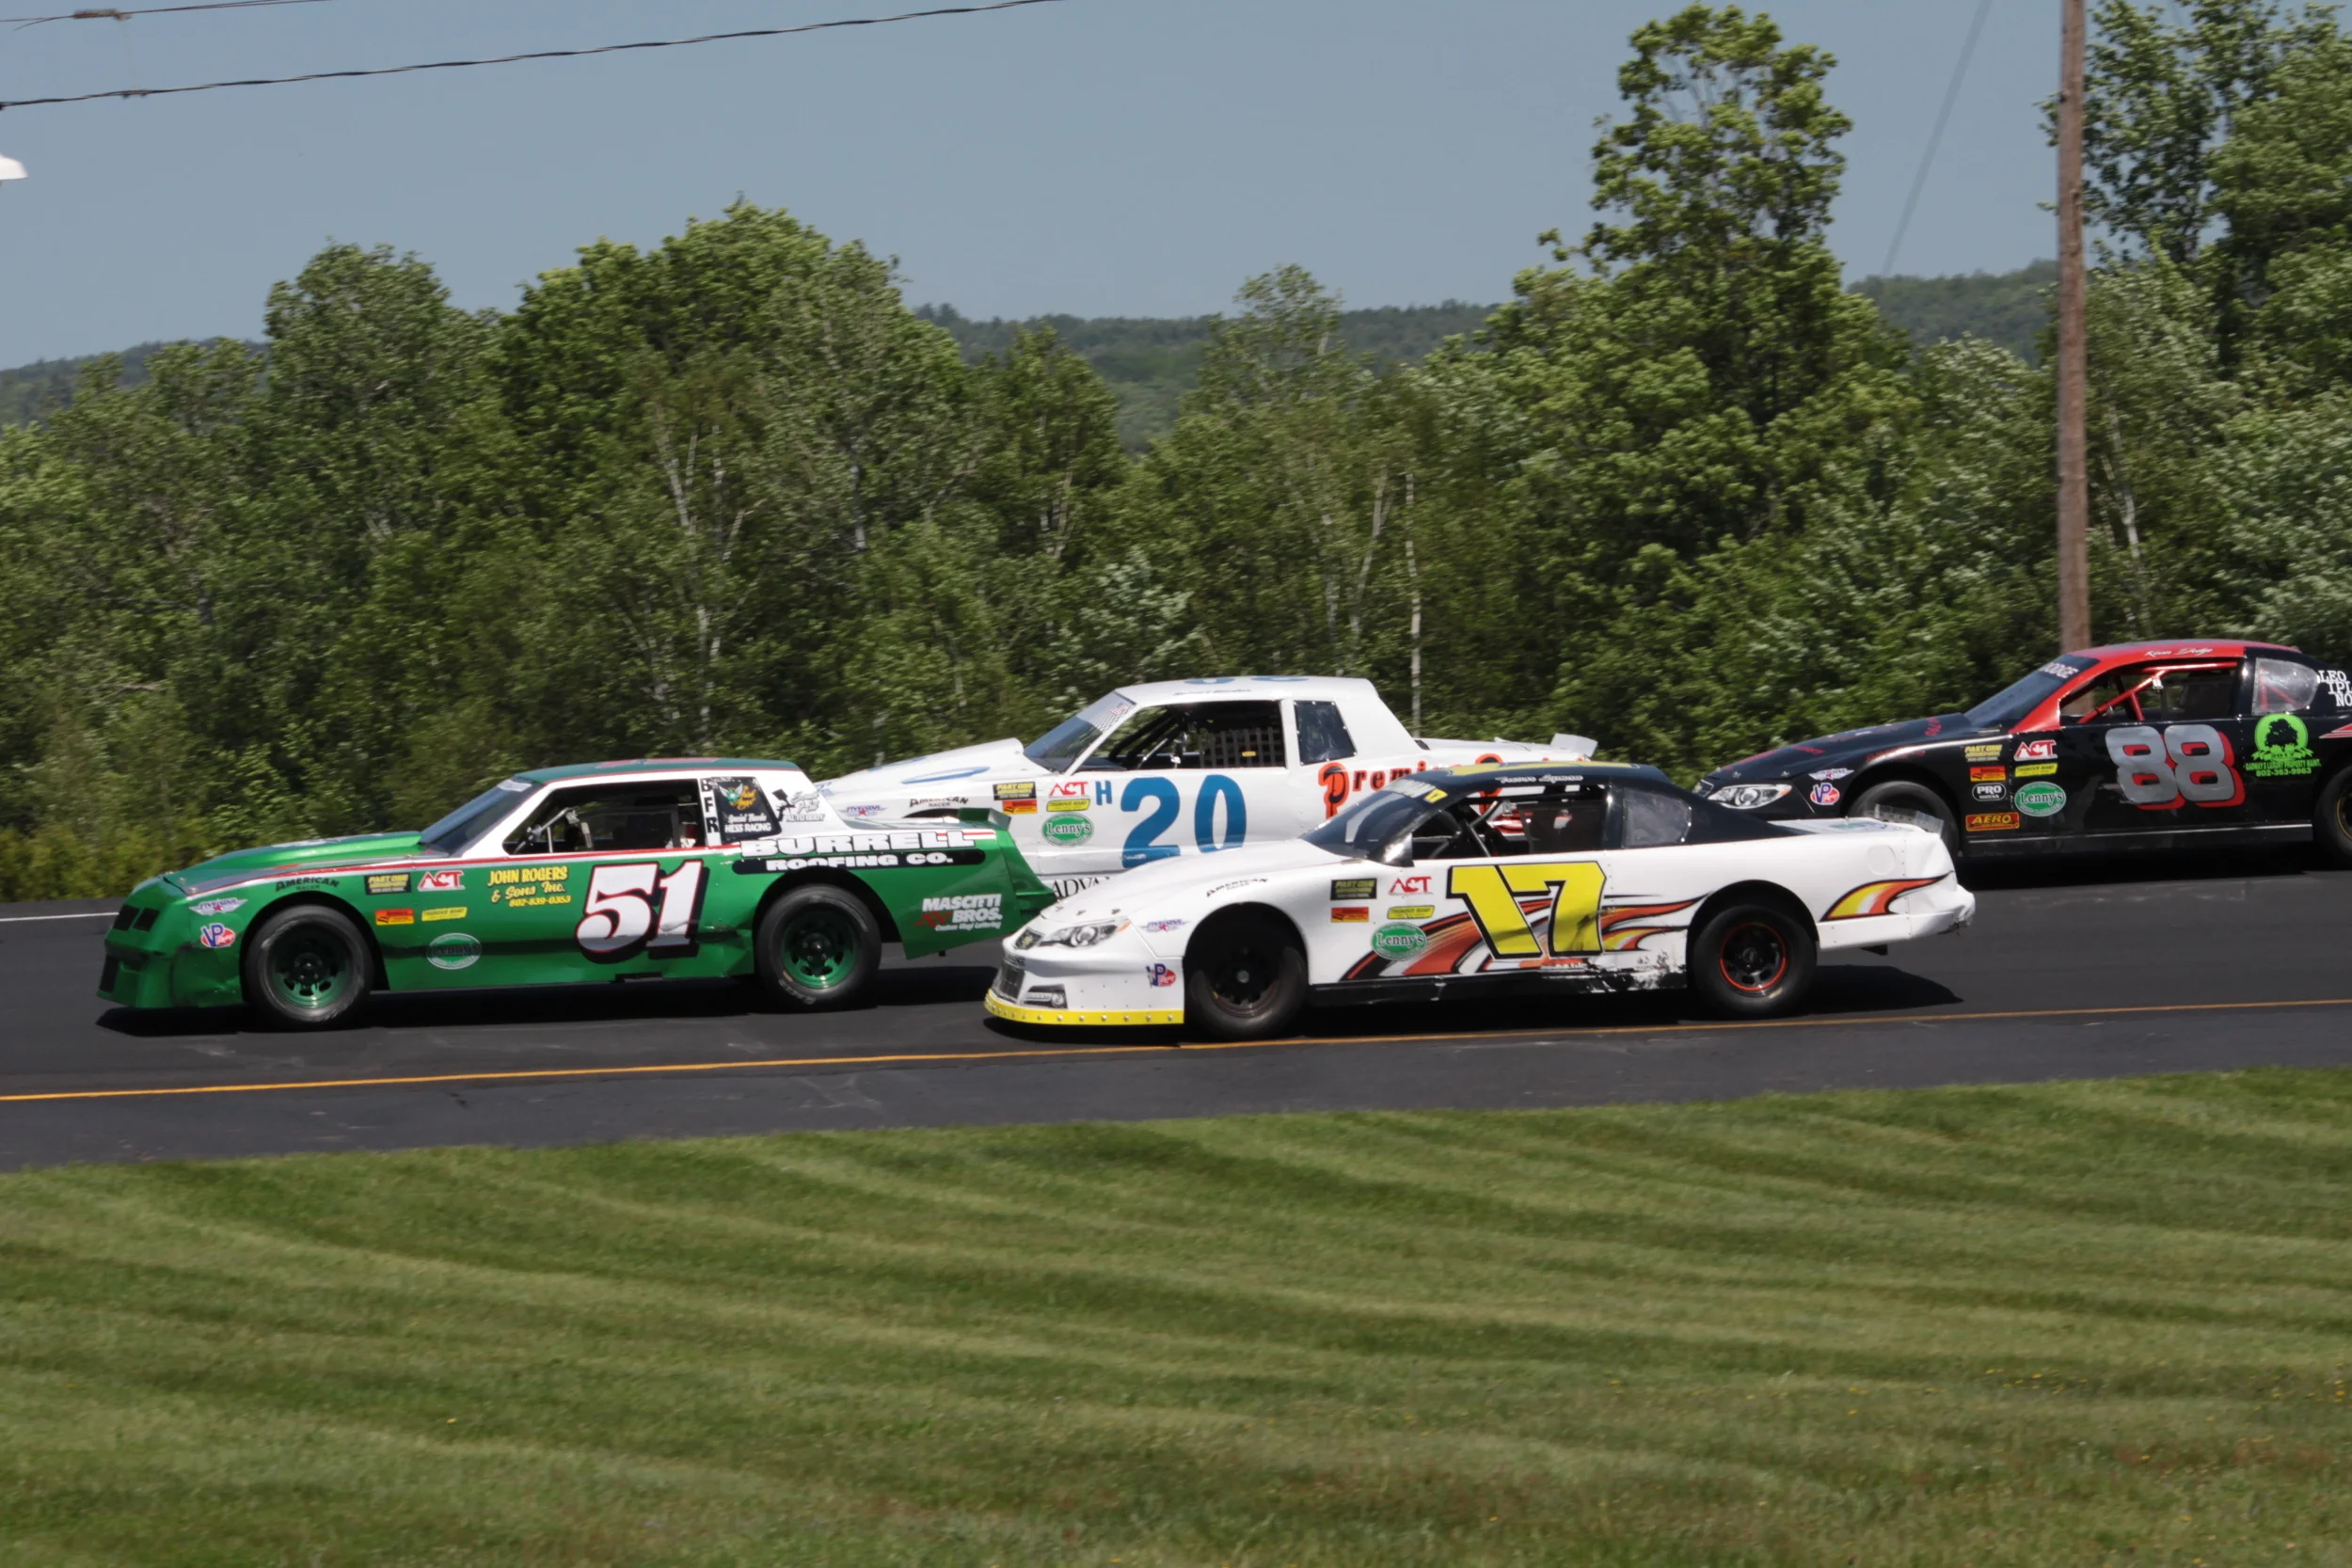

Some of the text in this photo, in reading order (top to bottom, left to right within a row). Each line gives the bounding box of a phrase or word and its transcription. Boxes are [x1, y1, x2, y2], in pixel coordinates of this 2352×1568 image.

[2318, 670, 2347, 684] LEO
[2014, 740, 2058, 760] ACT
[2106, 724, 2246, 810] 88
[1049, 782, 1089, 797] ACT
[1814, 783, 1832, 803] VP
[1977, 784, 2002, 794] PRO
[910, 796, 969, 807] AMERICAN
[2019, 791, 2063, 806] Lenny's
[724, 822, 772, 833] HESS RACING
[1095, 774, 1247, 868] H 20
[1972, 815, 2011, 824] AERO
[1047, 822, 1090, 836] Lenny's
[741, 831, 976, 857] BURRELL
[766, 852, 953, 872] ROOFING CO.
[276, 877, 340, 892] AMERICAN
[419, 871, 465, 889] ACT
[487, 865, 568, 886] JOHN ROGERS
[491, 889, 501, 903] &
[505, 885, 536, 899] Sons
[1053, 876, 1110, 899] ADV
[1389, 876, 1432, 894] ACT
[575, 859, 709, 961] 51
[922, 894, 1002, 911] MASCITTI
[1446, 861, 1607, 959] 17
[952, 908, 1003, 923] BROS.
[201, 923, 224, 948] VP
[1376, 932, 1424, 948] Lenny's
